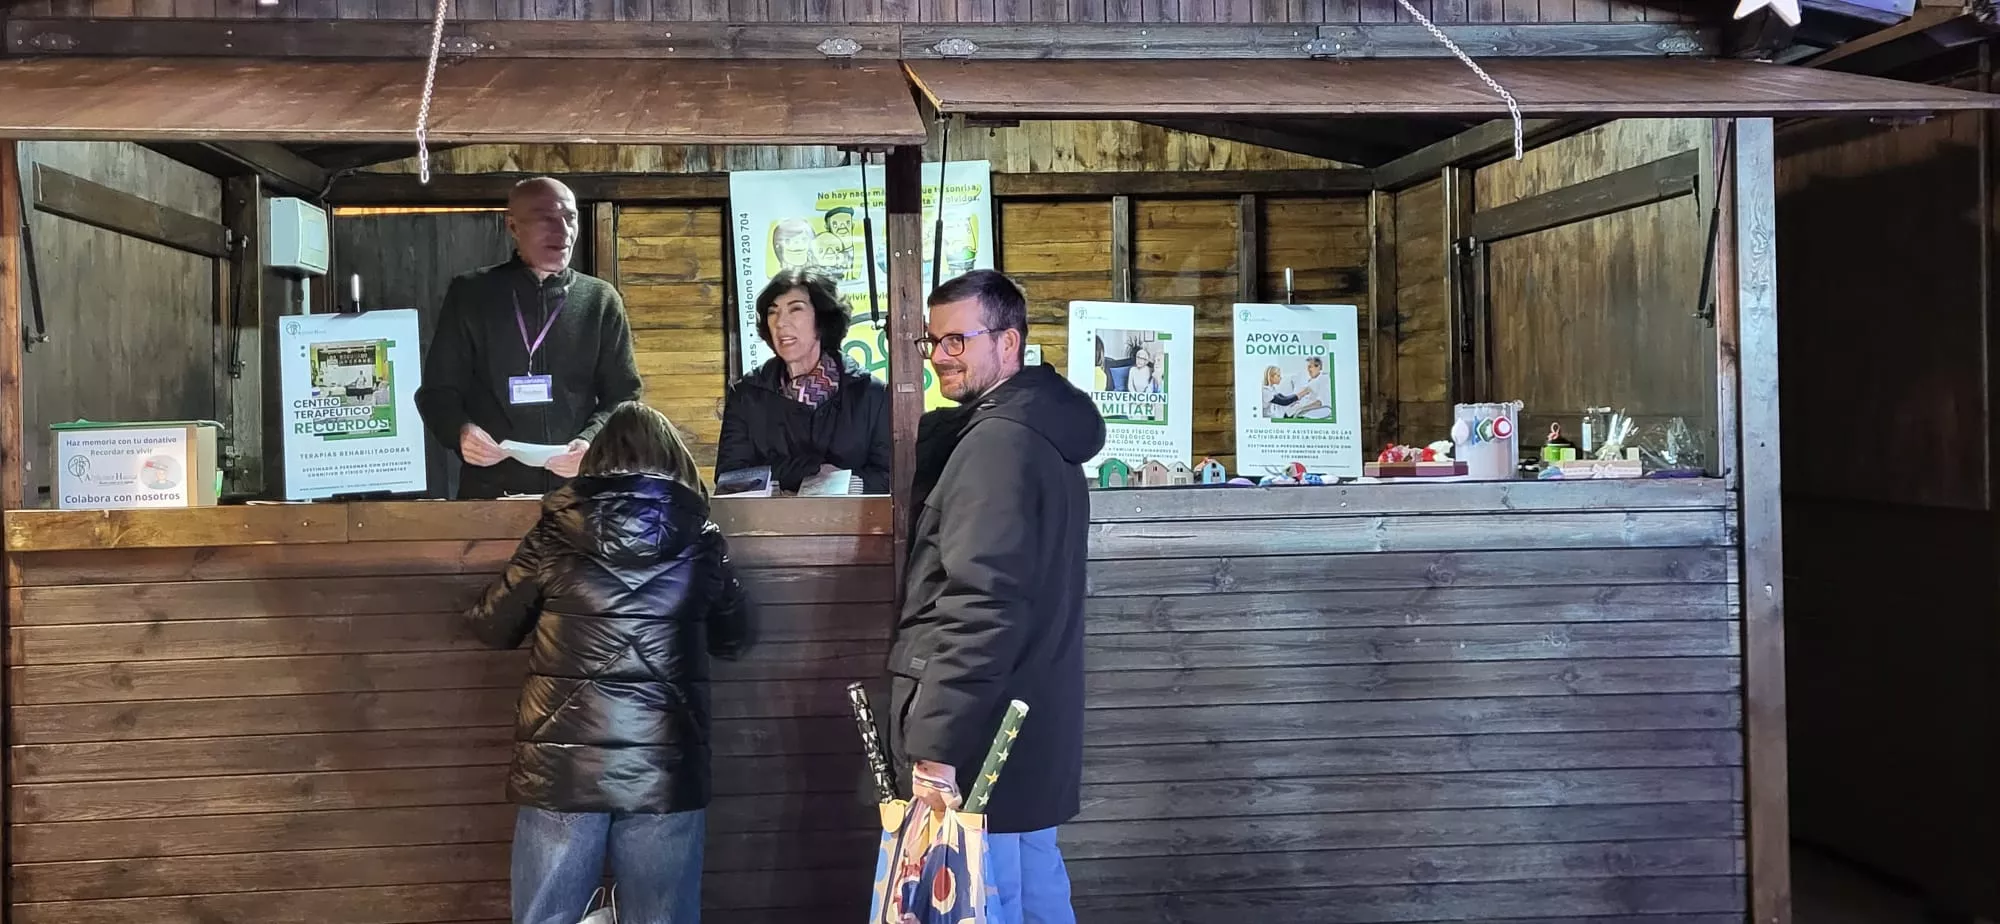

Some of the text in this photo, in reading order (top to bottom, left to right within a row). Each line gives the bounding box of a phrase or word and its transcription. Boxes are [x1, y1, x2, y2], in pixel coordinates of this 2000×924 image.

[818, 192, 829, 200] No
[832, 191, 847, 200] hay
[740, 213, 749, 232] 704
[741, 235, 750, 254] 230
[743, 257, 752, 275] 974
[745, 279, 756, 327] Teléfono
[1246, 333, 1300, 343] APOYO A
[1245, 344, 1325, 356] DOMICILIO
[293, 397, 340, 409] CENTRO
[294, 419, 388, 434] RECUERDOS
[66, 438, 81, 447] Haz
[82, 437, 117, 446] memoria
[143, 436, 177, 444] donativo
[90, 448, 125, 457] Recordar
[300, 447, 411, 460] TERAPIAS REHABILITADORAS
[65, 492, 180, 504] Colabora con nosotros
